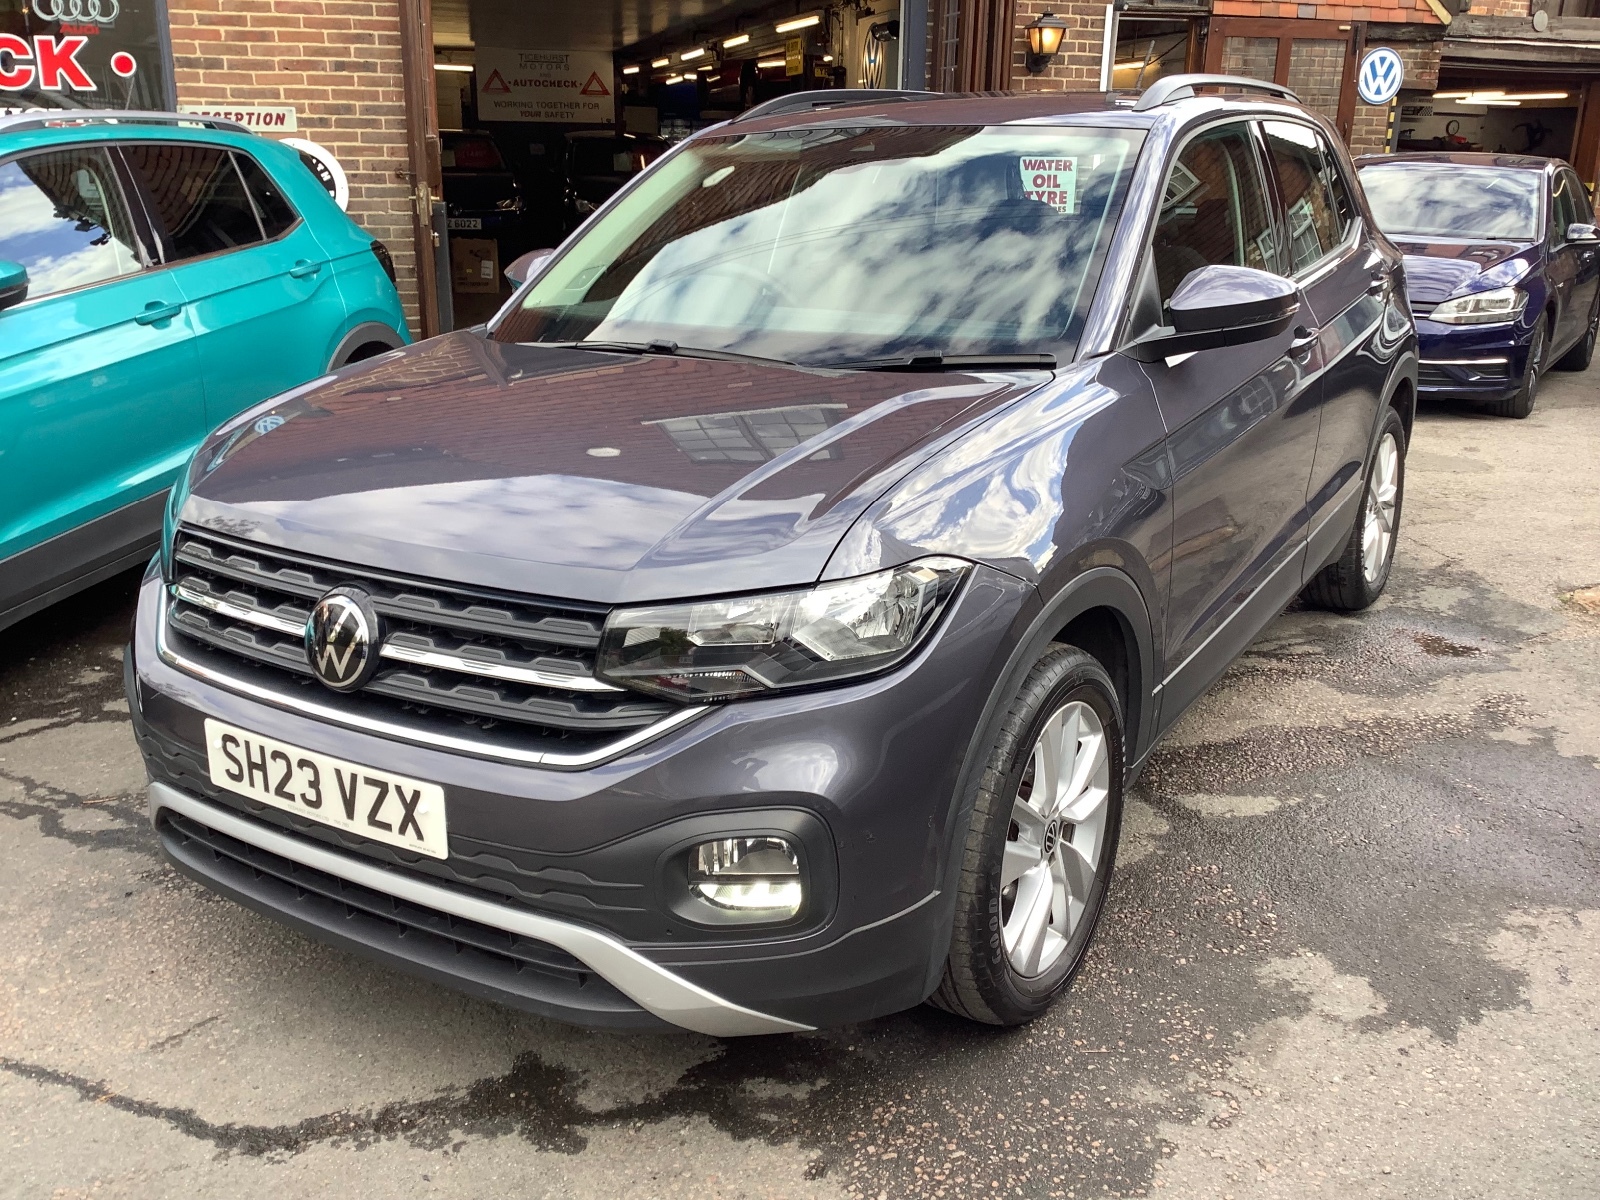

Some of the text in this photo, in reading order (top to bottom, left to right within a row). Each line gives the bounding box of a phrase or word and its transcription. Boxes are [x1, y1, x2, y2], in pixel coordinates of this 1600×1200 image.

[518, 53, 570, 63] TICEHURST
[519, 63, 570, 71] MOTORS
[493, 100, 600, 110] WORKING TOGETHER FOR
[189, 112, 286, 126] RCEPTION
[520, 110, 575, 119] YOUR SAFETY
[1022, 159, 1073, 171] WATER
[1032, 174, 1061, 189] OIL
[454, 218, 478, 229] 6022
[221, 733, 425, 842] SH23 VZX
